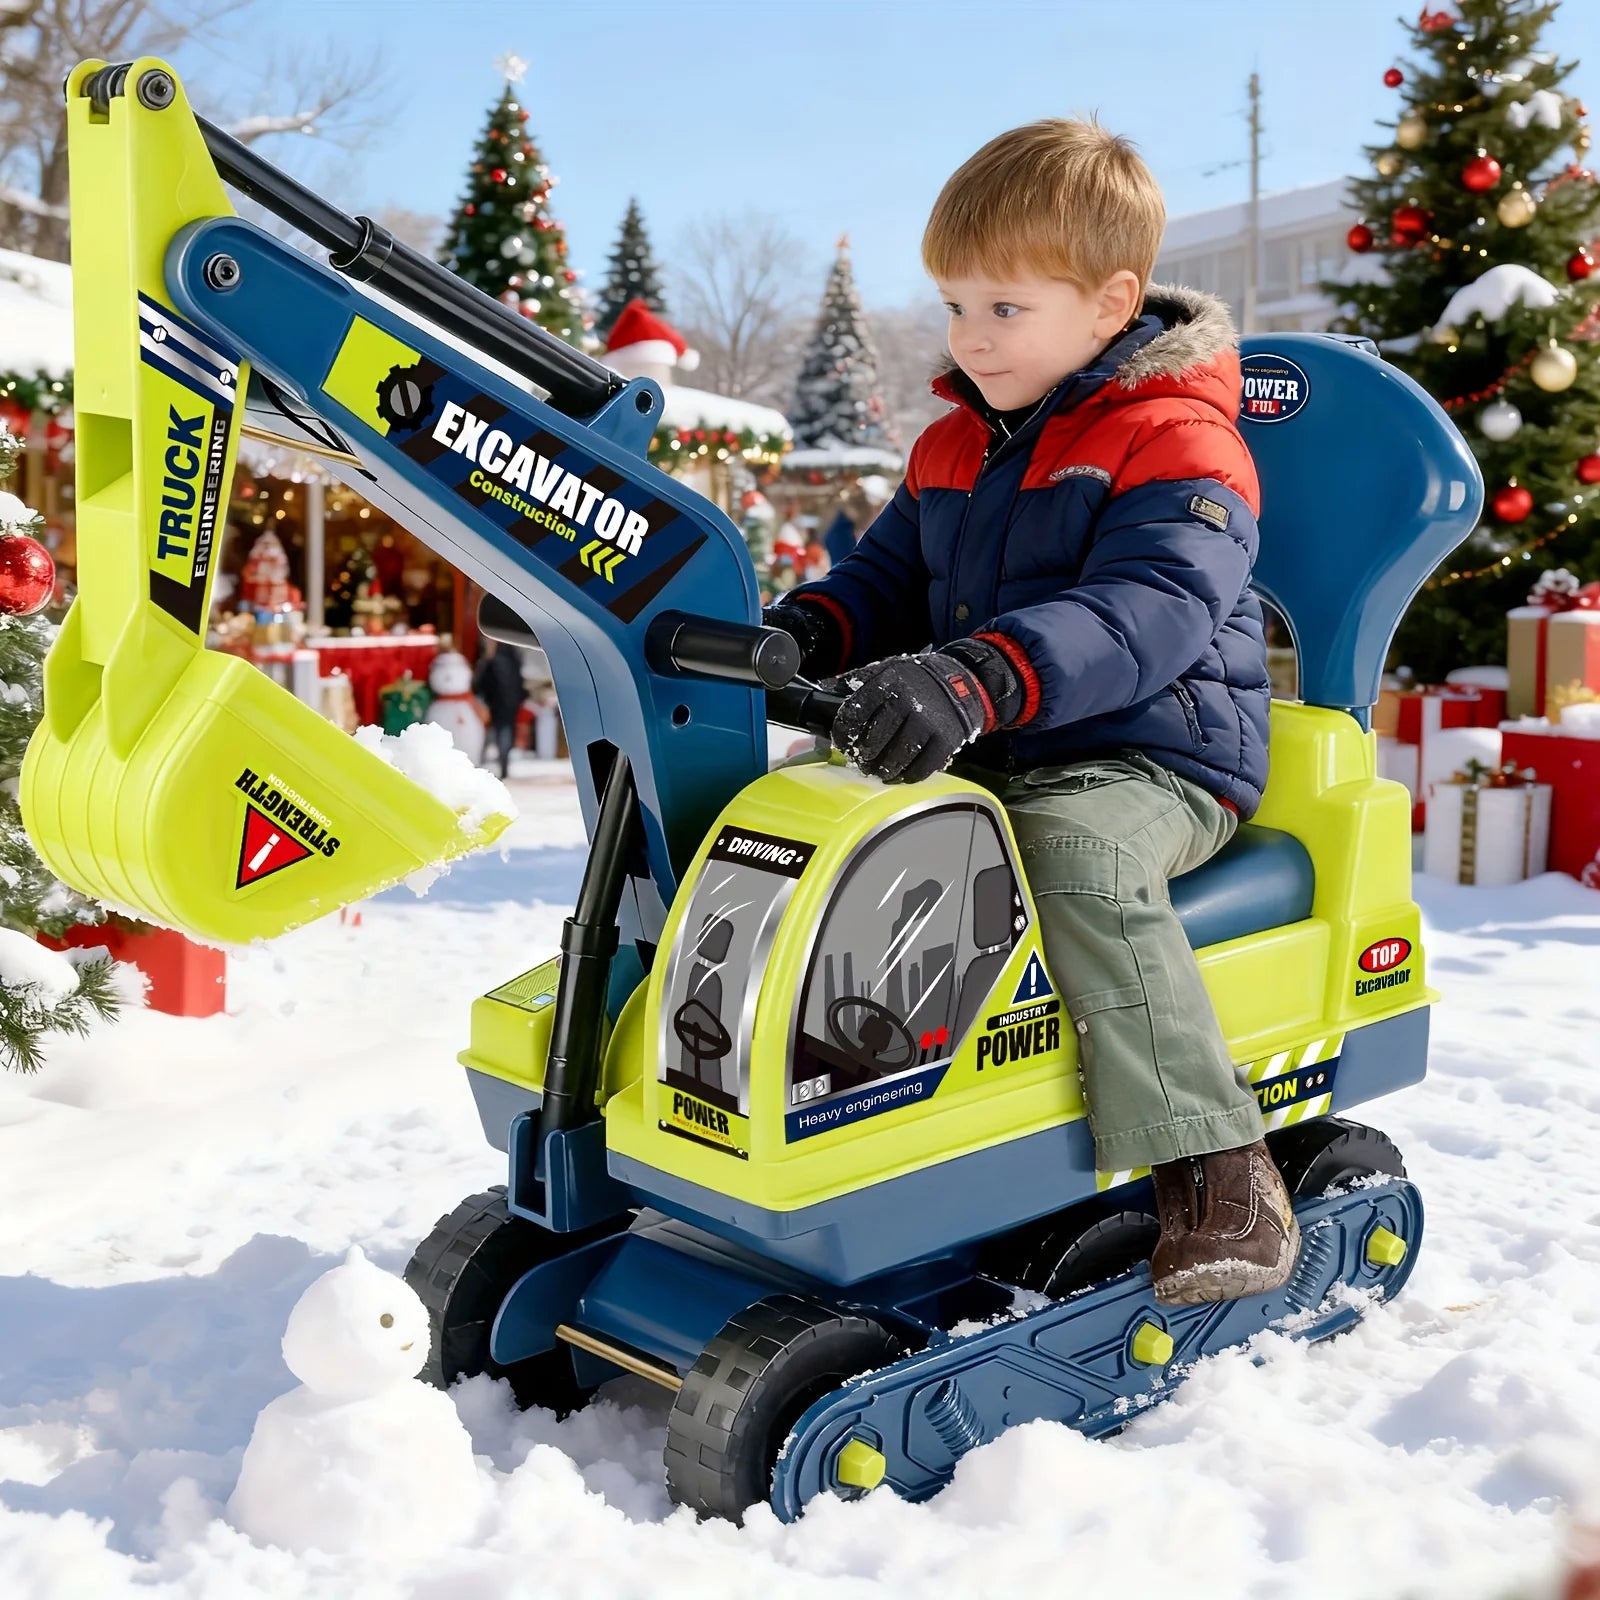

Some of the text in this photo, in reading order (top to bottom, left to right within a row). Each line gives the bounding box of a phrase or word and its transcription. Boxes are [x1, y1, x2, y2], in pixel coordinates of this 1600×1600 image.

[1251, 399, 1276, 414] FUL
[157, 403, 206, 560] TRUCK
[194, 419, 226, 578] ENGINEERING
[431, 400, 650, 557] EXCAVATOR
[469, 470, 577, 542] Construction
[234, 767, 341, 858] STRENGTH
[267, 773, 333, 828] CONSTRUCTION
[726, 836, 797, 866] DRIVING
[1370, 942, 1401, 969] TOP
[1355, 968, 1411, 997] Excavator
[999, 1004, 1049, 1027] INDUSTRY
[976, 1016, 1060, 1072] POWER
[673, 1091, 730, 1136] POWER
[799, 1081, 924, 1129] Heavy engineering
